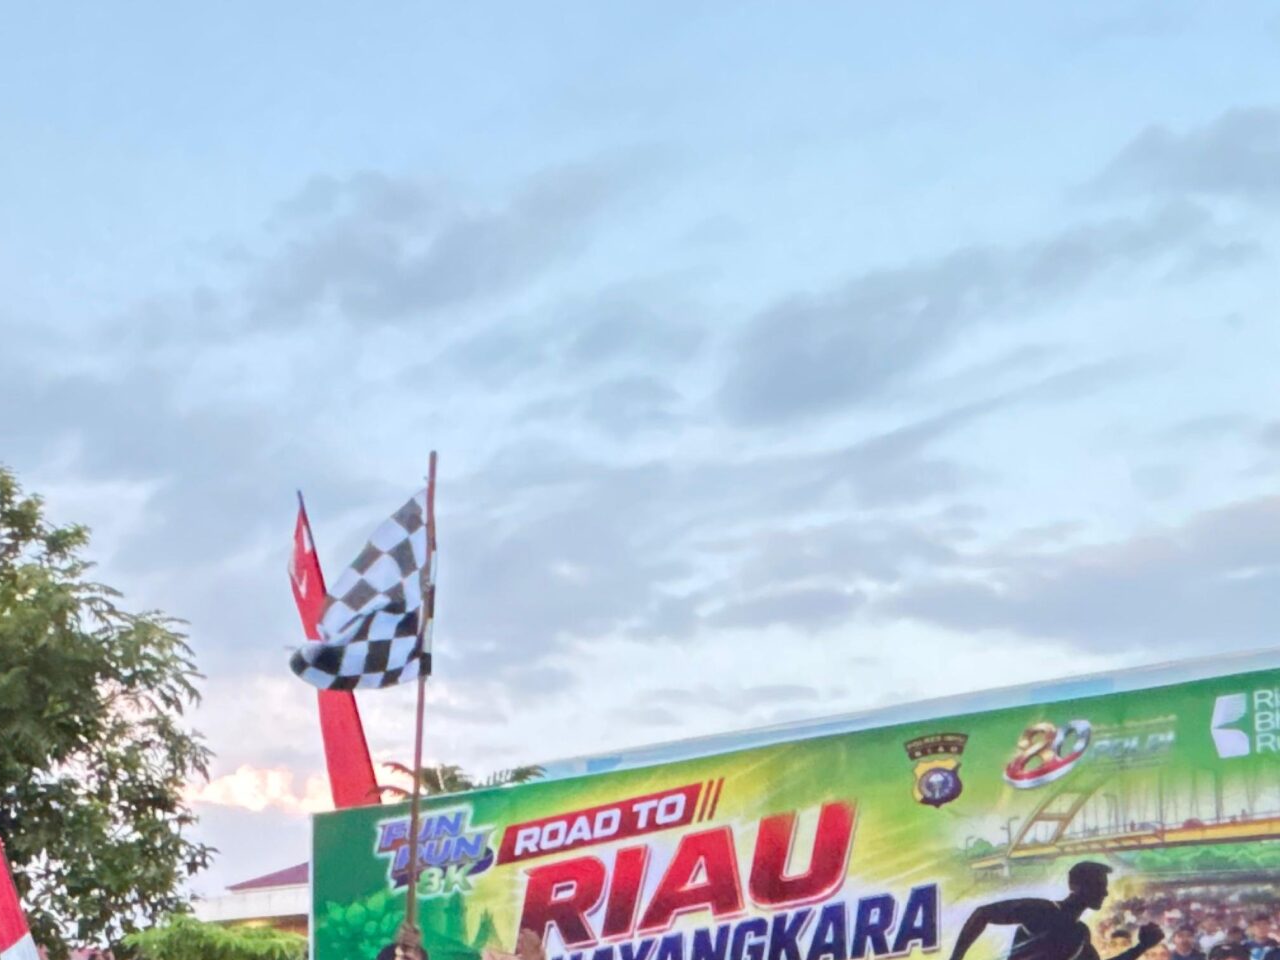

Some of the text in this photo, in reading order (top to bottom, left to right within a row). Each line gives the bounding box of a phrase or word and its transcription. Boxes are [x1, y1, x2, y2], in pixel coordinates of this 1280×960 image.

[514, 793, 687, 856] ROAD TO
[417, 864, 473, 895] 8K
[518, 798, 859, 954] RIAU
